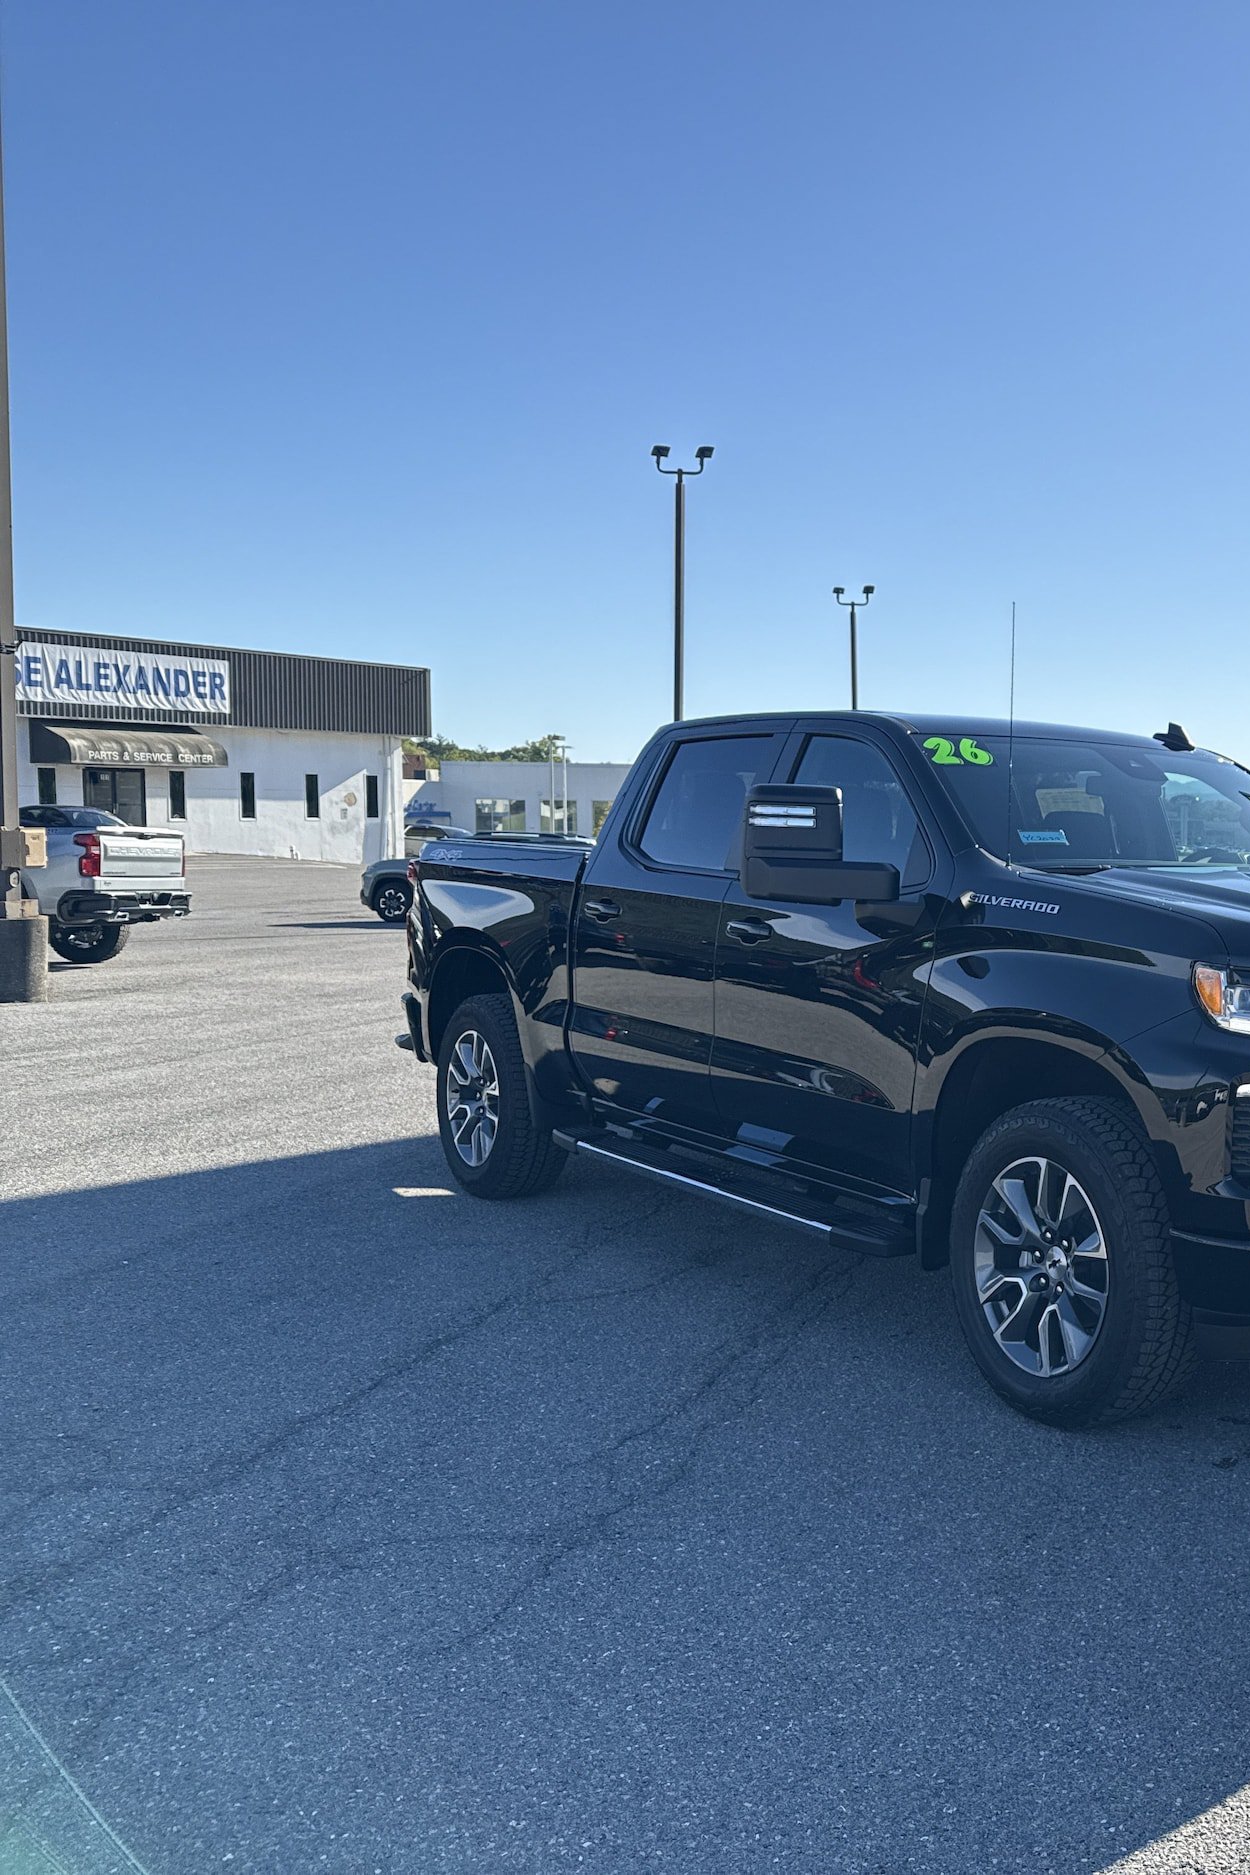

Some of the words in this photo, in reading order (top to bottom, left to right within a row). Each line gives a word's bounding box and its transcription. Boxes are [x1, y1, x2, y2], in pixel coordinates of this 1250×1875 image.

[53, 658, 226, 701] ALEXANDER
[88, 751, 119, 761] PARTS
[122, 751, 130, 761] &
[133, 751, 173, 762] SERVICE
[178, 753, 214, 764] CENTER
[922, 737, 994, 766] 26
[970, 894, 1060, 915] SILVERADO
